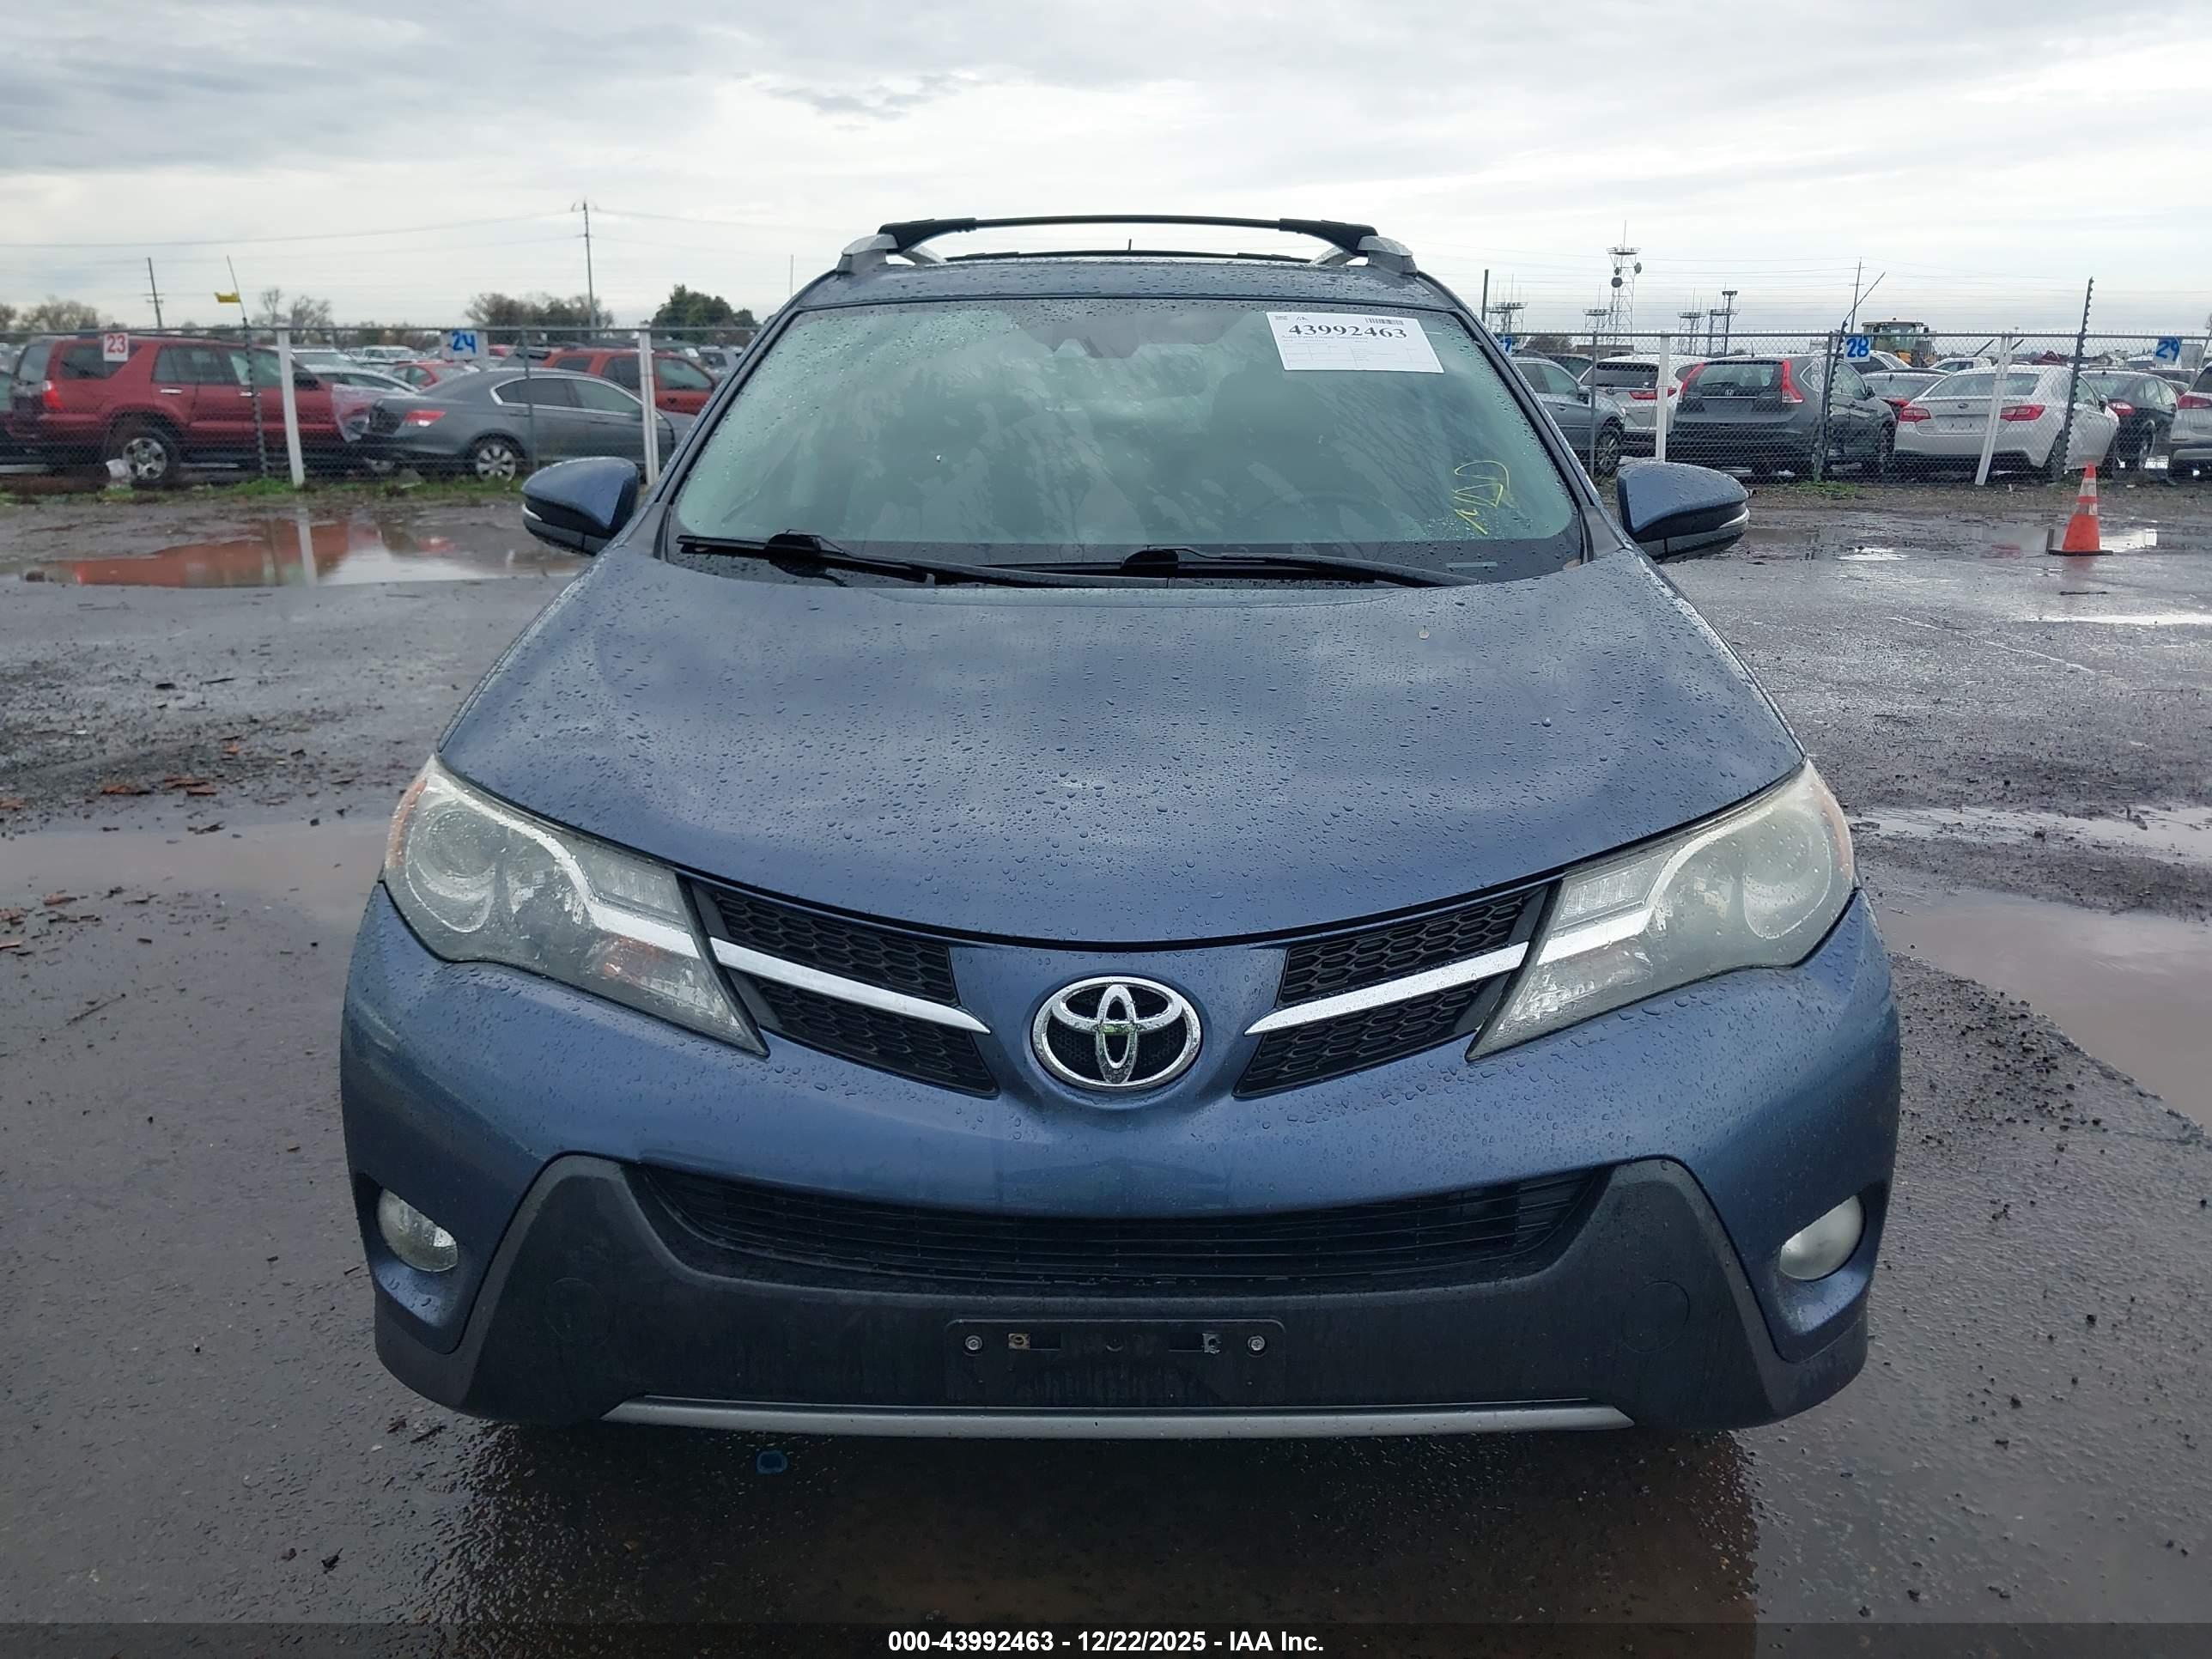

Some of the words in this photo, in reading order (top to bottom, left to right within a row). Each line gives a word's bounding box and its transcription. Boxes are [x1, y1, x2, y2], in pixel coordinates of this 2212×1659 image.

[1289, 324, 1407, 339] 43992463
[106, 334, 125, 354] 23
[453, 330, 477, 355] 24
[1500, 336, 1512, 353] 7
[1846, 336, 1869, 358] 28
[2155, 337, 2180, 362] 29
